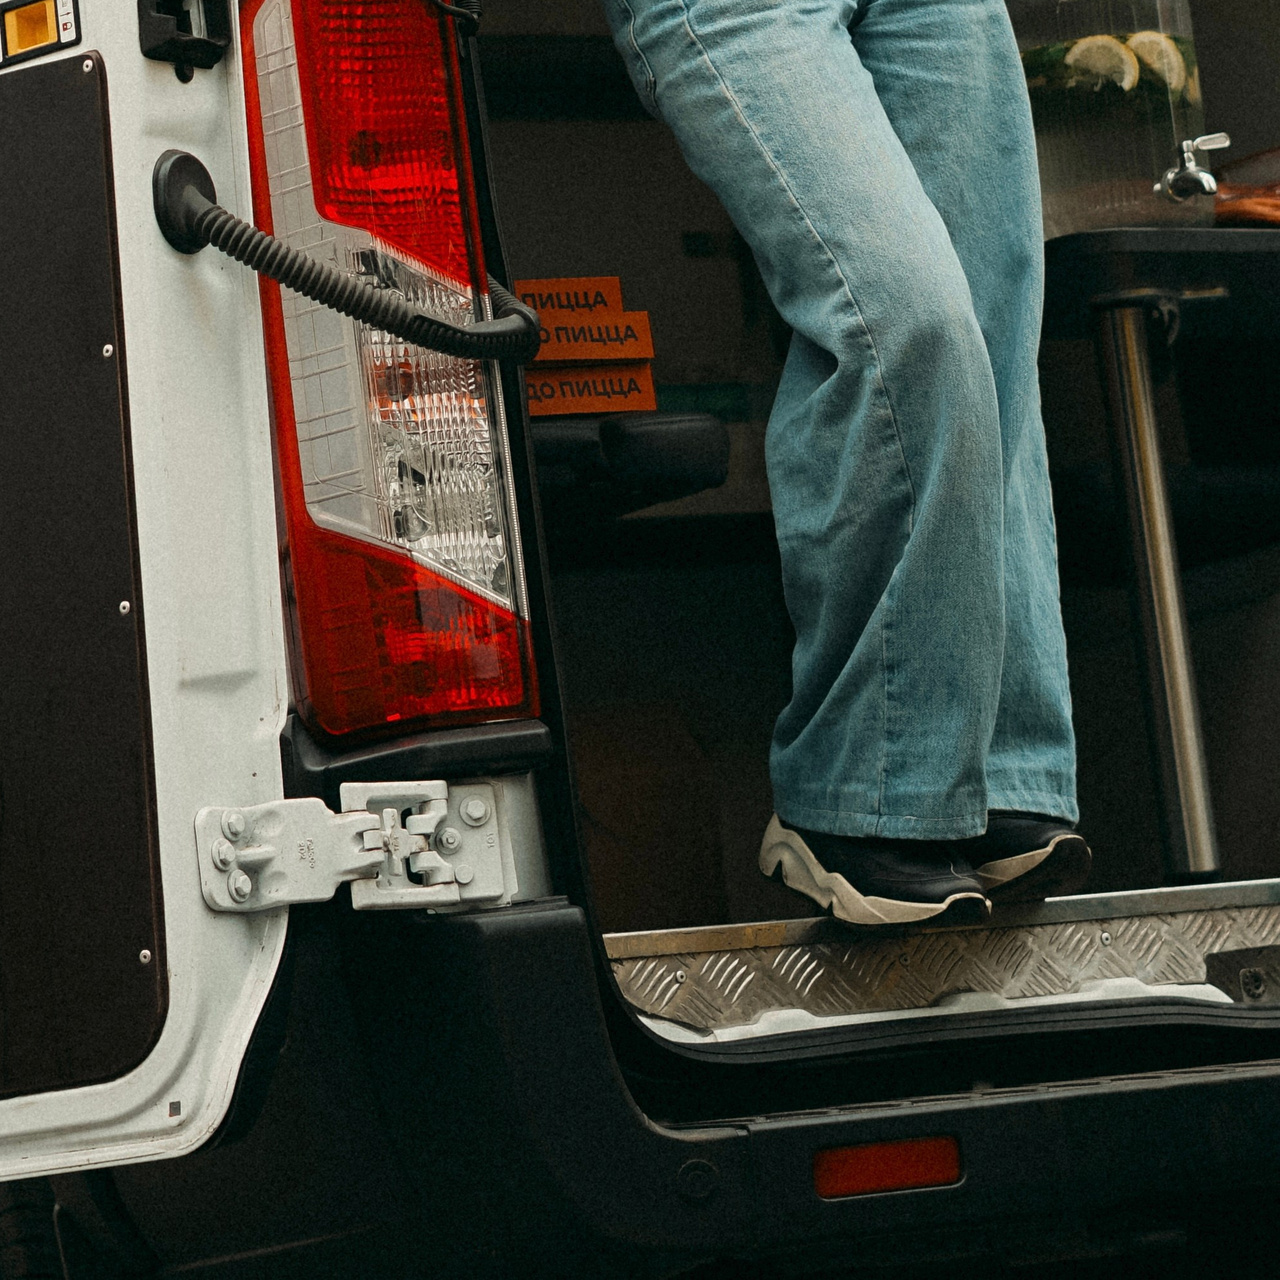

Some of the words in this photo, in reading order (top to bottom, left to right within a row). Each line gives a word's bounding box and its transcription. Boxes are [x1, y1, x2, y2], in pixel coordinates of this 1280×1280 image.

[520, 290, 608, 312] ПИЦЦА
[554, 325, 639, 346] ПИЦЦА
[526, 381, 556, 404] ДО
[558, 377, 642, 399] ПИЦЦА
